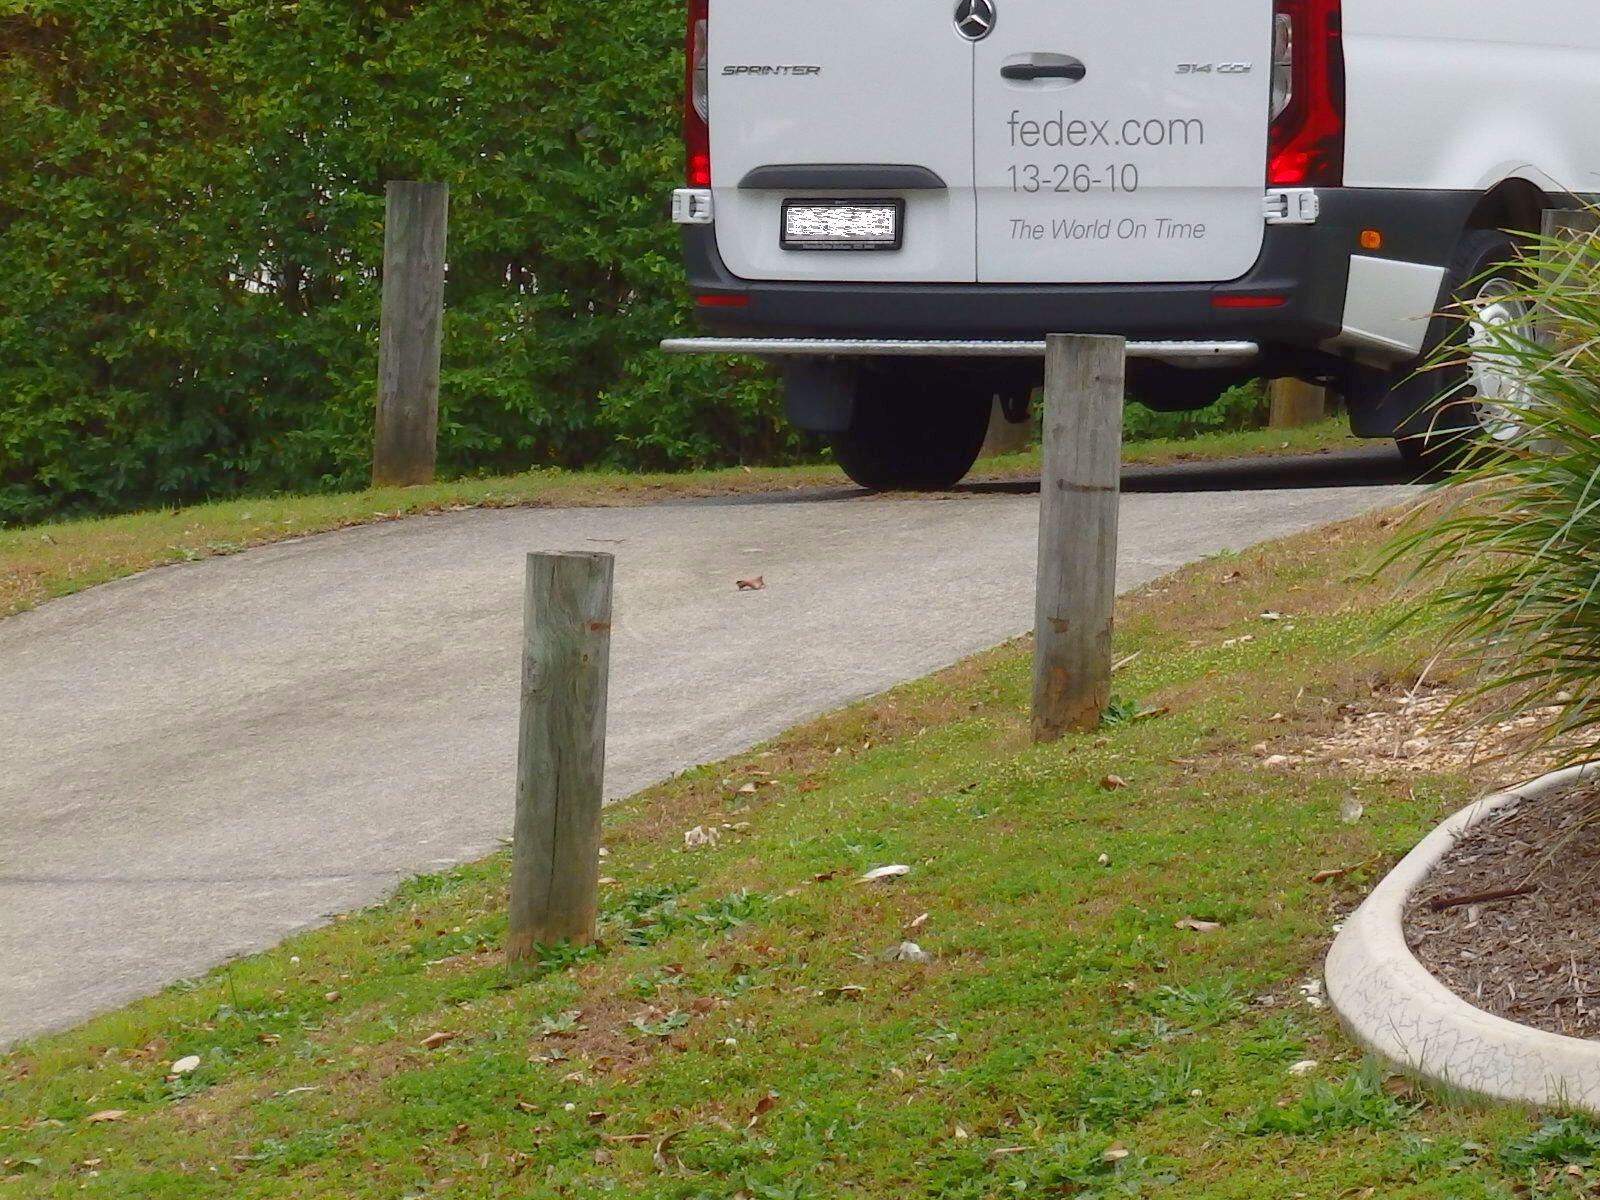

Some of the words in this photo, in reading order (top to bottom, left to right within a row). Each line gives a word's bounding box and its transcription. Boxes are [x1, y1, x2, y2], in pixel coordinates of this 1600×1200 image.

[721, 65, 821, 76] SPRINTER
[1175, 63, 1212, 74] 314
[1007, 110, 1204, 147] fedex.com
[1007, 163, 1139, 193] 13-26-10
[1009, 219, 1045, 240] The
[1052, 218, 1112, 240] World
[1117, 218, 1147, 240] On
[1155, 218, 1206, 240] Time
